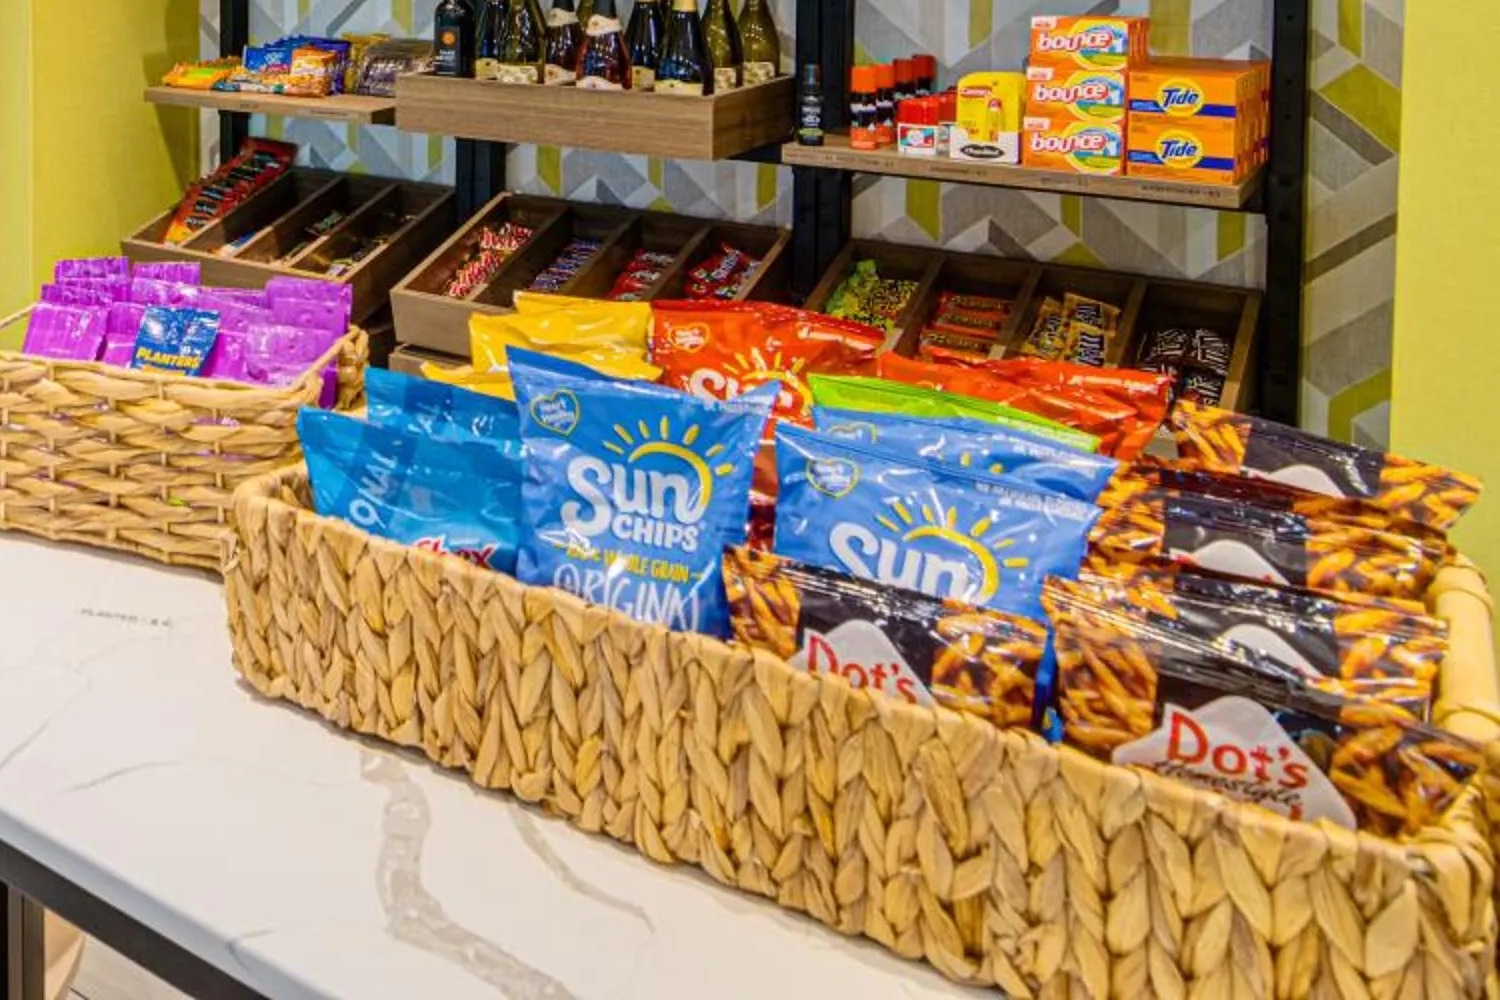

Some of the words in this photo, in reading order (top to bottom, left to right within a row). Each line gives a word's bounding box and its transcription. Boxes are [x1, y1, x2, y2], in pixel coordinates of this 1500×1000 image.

[1037, 31, 1114, 51] bounce
[1034, 83, 1109, 103] bounce
[1161, 87, 1199, 108] Tide
[1031, 132, 1107, 152] bounce
[1160, 138, 1198, 159] Tide
[135, 346, 201, 370] PLANTERS
[560, 455, 710, 537] Sun
[610, 514, 700, 552] CHIPS
[828, 520, 985, 602] Sun
[806, 633, 918, 704] Dot's
[1167, 709, 1310, 789] Dot's
